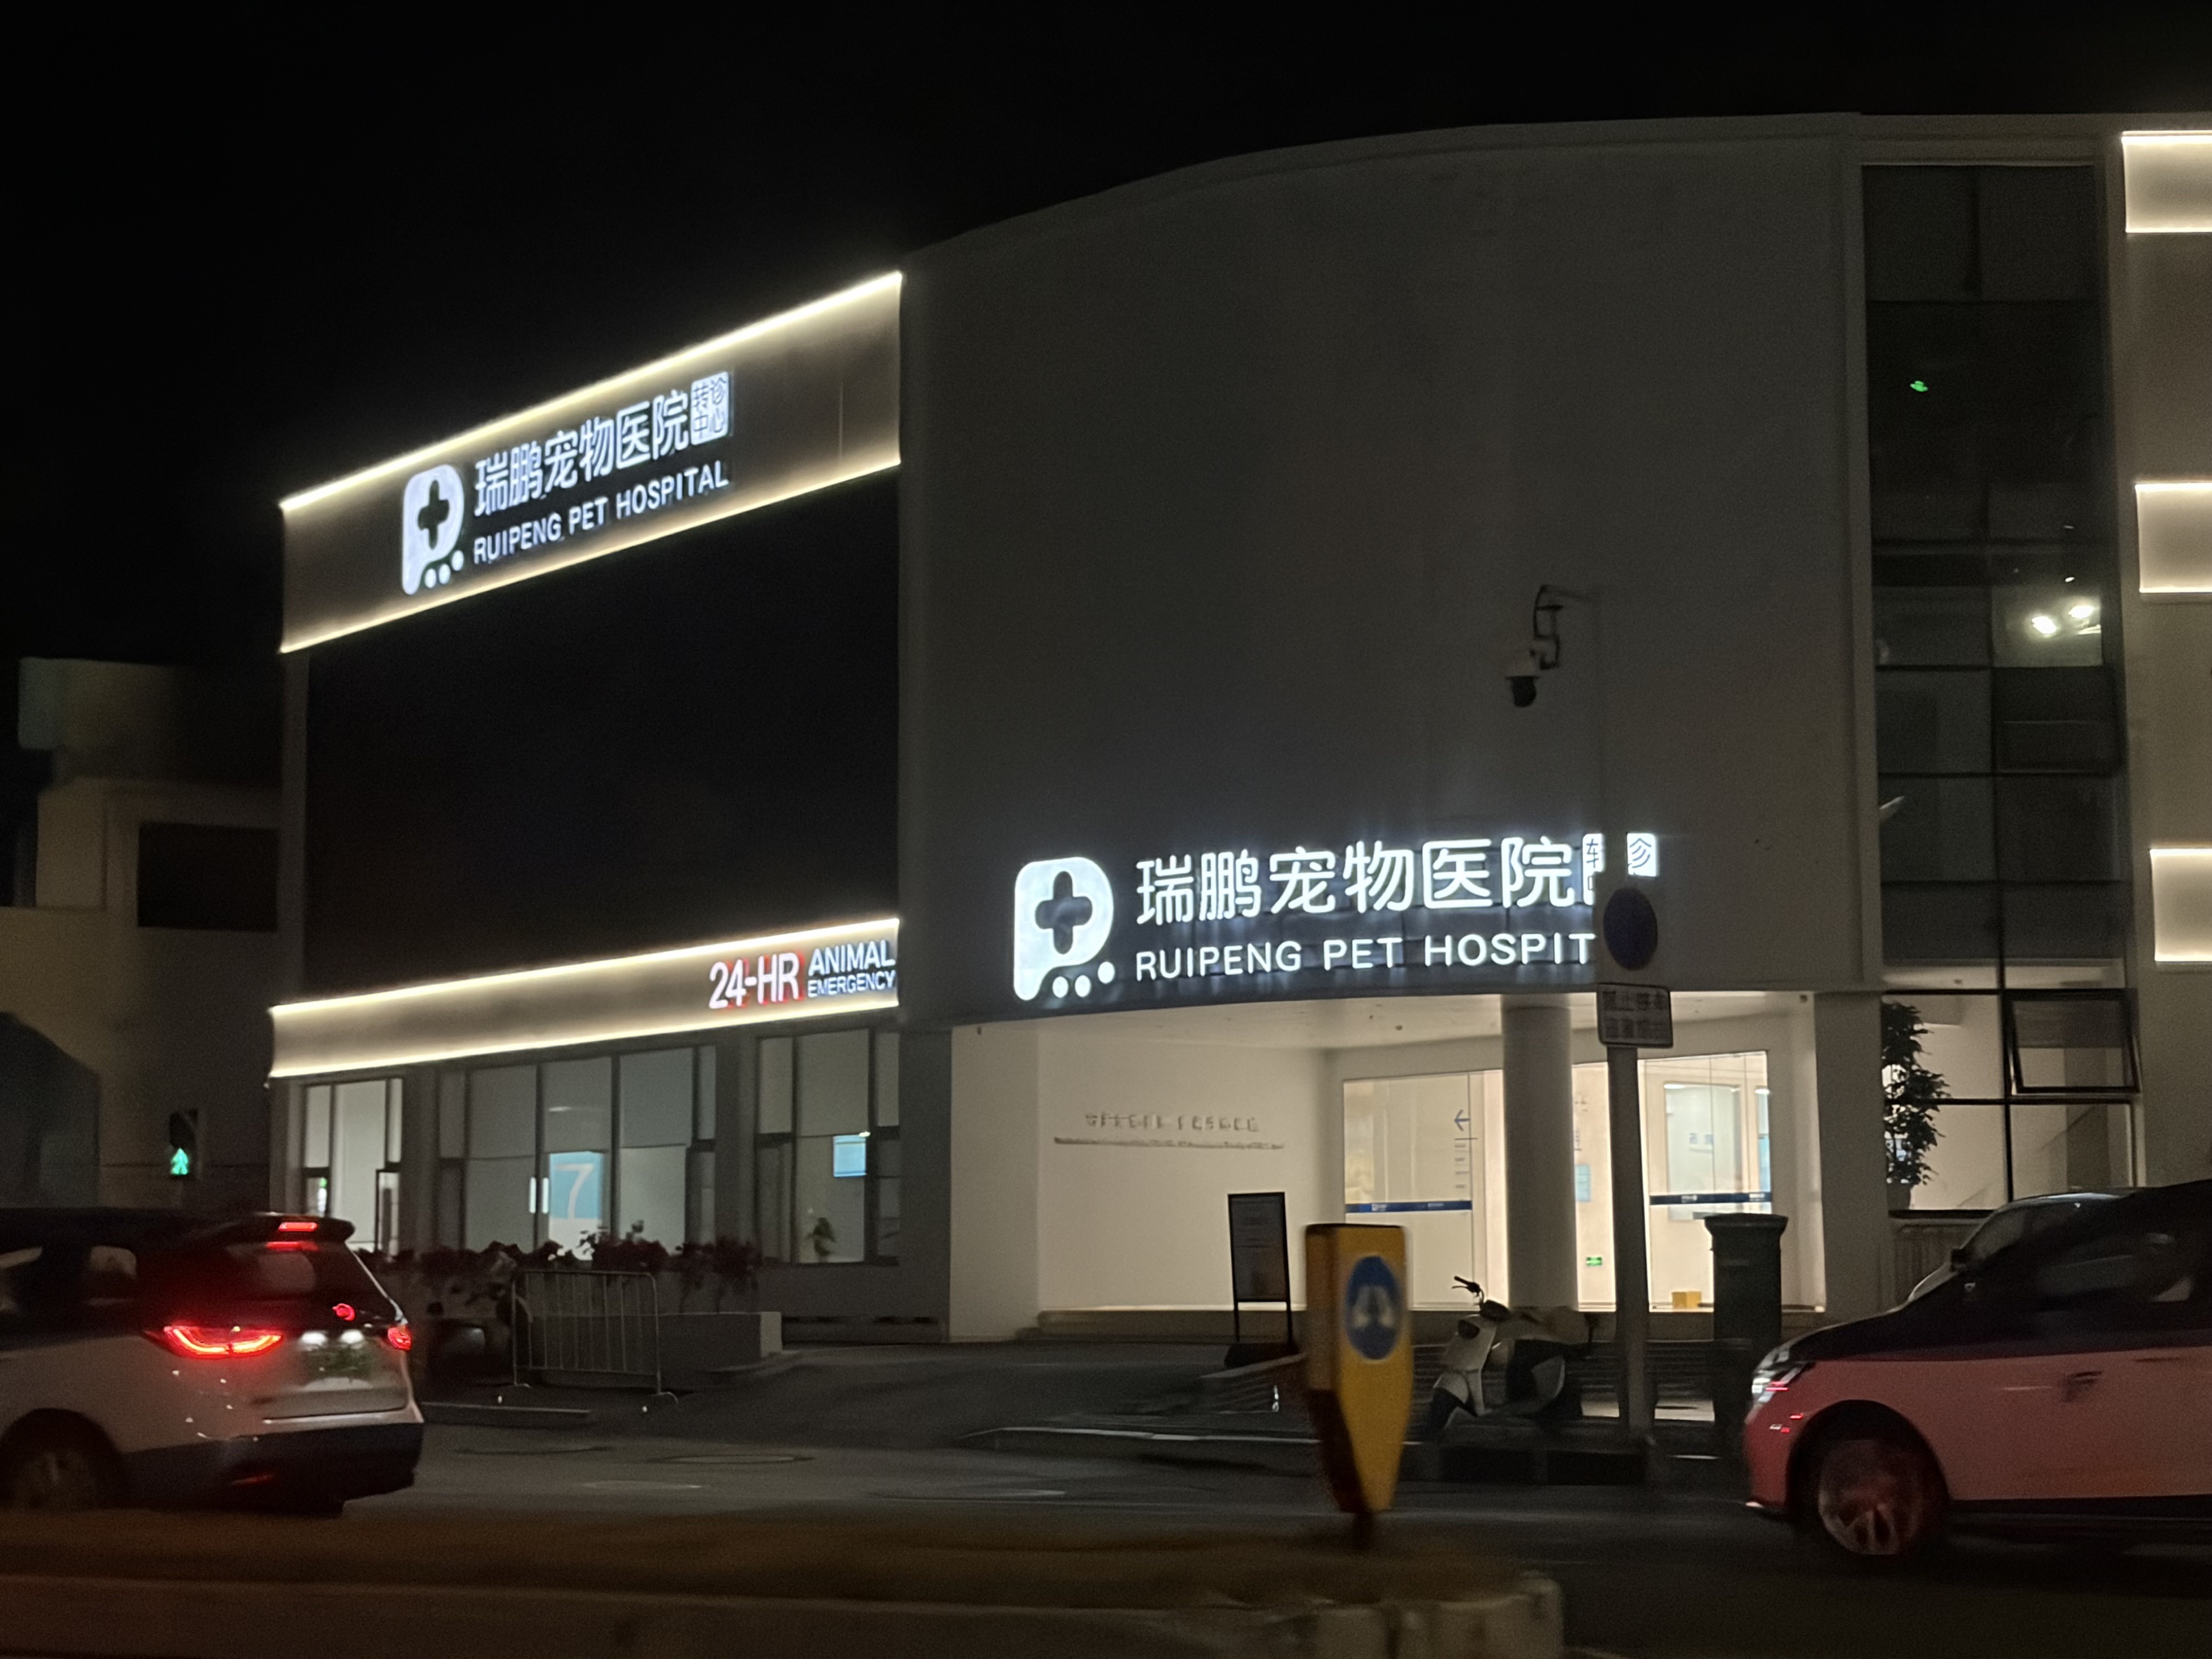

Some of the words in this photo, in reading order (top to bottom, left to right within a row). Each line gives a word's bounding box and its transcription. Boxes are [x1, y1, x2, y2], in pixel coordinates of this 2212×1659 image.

[474, 389, 688, 517] 瑞鹏宠物医院
[474, 512, 562, 564] RUIPENG
[568, 496, 608, 535] PET
[616, 460, 729, 520] HOSPITAL
[1136, 836, 1575, 926] 瑞鹏宠物医院
[709, 952, 800, 1009] 24-HR
[807, 970, 896, 998] EMERGENCY
[808, 939, 896, 976] ANIMAL
[1136, 941, 1302, 981] RUIPENG
[1323, 937, 1403, 971] PET
[1424, 933, 1596, 967] HOSPIT
